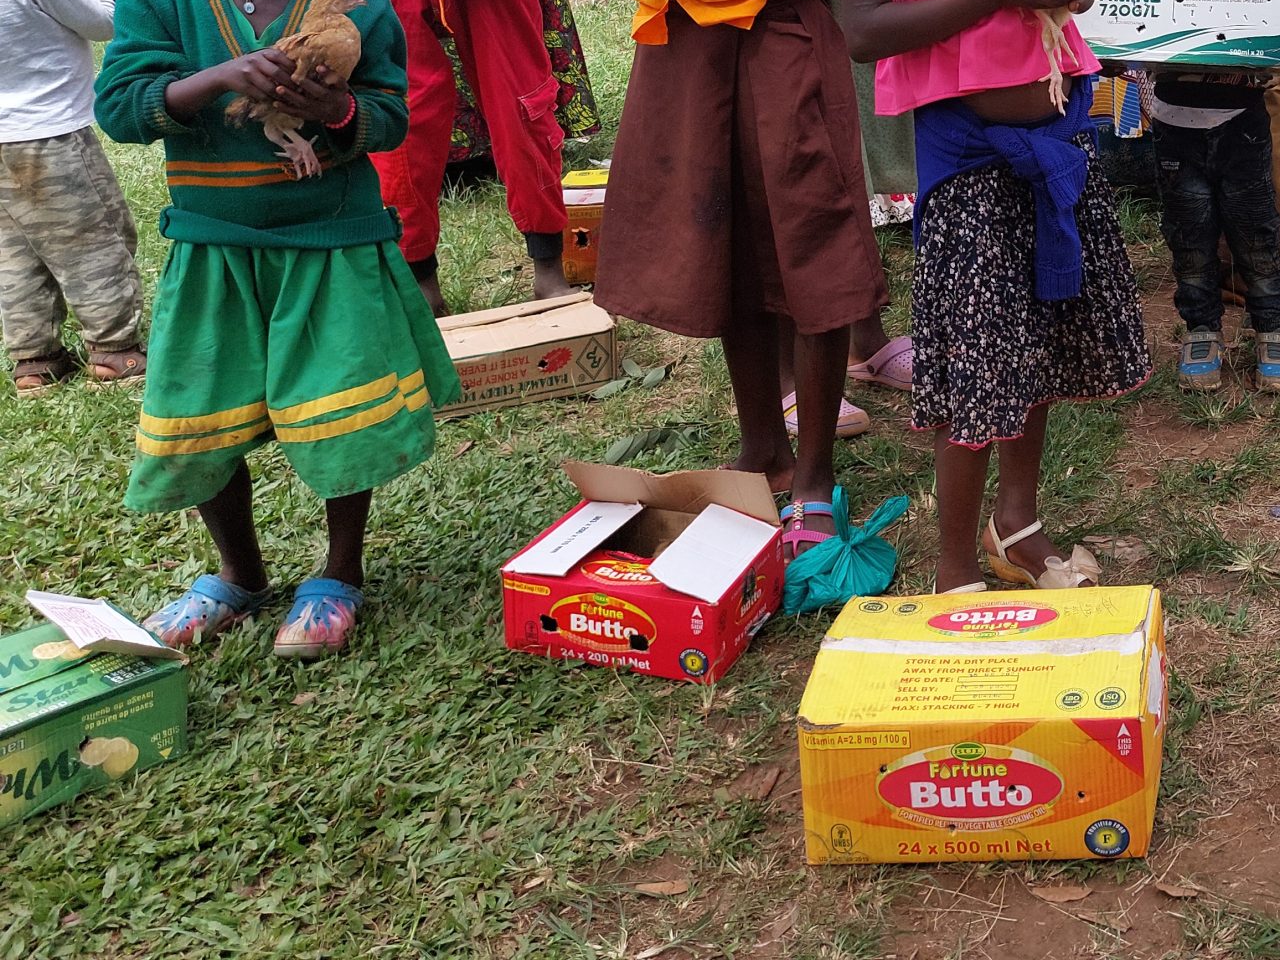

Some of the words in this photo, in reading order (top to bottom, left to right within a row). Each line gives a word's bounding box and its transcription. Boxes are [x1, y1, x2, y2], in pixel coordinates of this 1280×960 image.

[490, 360, 499, 370] IT
[500, 355, 530, 369] TASTE
[485, 371, 518, 384] RONEY
[518, 368, 527, 379] A
[595, 566, 653, 581] Butto
[580, 603, 625, 620] Fortune
[949, 608, 1037, 623] Butto
[570, 613, 640, 640] Butto
[962, 621, 1018, 631] Fortune
[560, 648, 575, 658] 24
[578, 652, 585, 660] x
[588, 651, 610, 664] 200
[628, 657, 651, 670] Net
[691, 659, 697, 667] F
[1006, 665, 1056, 673] SUNLIGHT
[7, 674, 94, 713] Star
[150, 731, 162, 743] UP
[162, 725, 180, 738] SIDE
[156, 737, 174, 748] THIS
[806, 735, 835, 745] Vitamin
[837, 735, 862, 744] A=2.8
[864, 736, 878, 745] mg
[884, 735, 899, 744] 100
[902, 737, 908, 745] g
[928, 761, 1008, 780] Fortune
[909, 779, 1033, 809] Butto
[899, 808, 934, 826] FORTIFIED
[964, 820, 1003, 830] VEGETABLE
[1004, 811, 1034, 827] COOKING
[1034, 807, 1046, 818] OIL
[1103, 833, 1112, 844] F
[897, 841, 922, 856] 24
[927, 844, 938, 855] x
[944, 840, 980, 855] 500
[987, 840, 1010, 854] ml
[1017, 839, 1053, 853] Net
